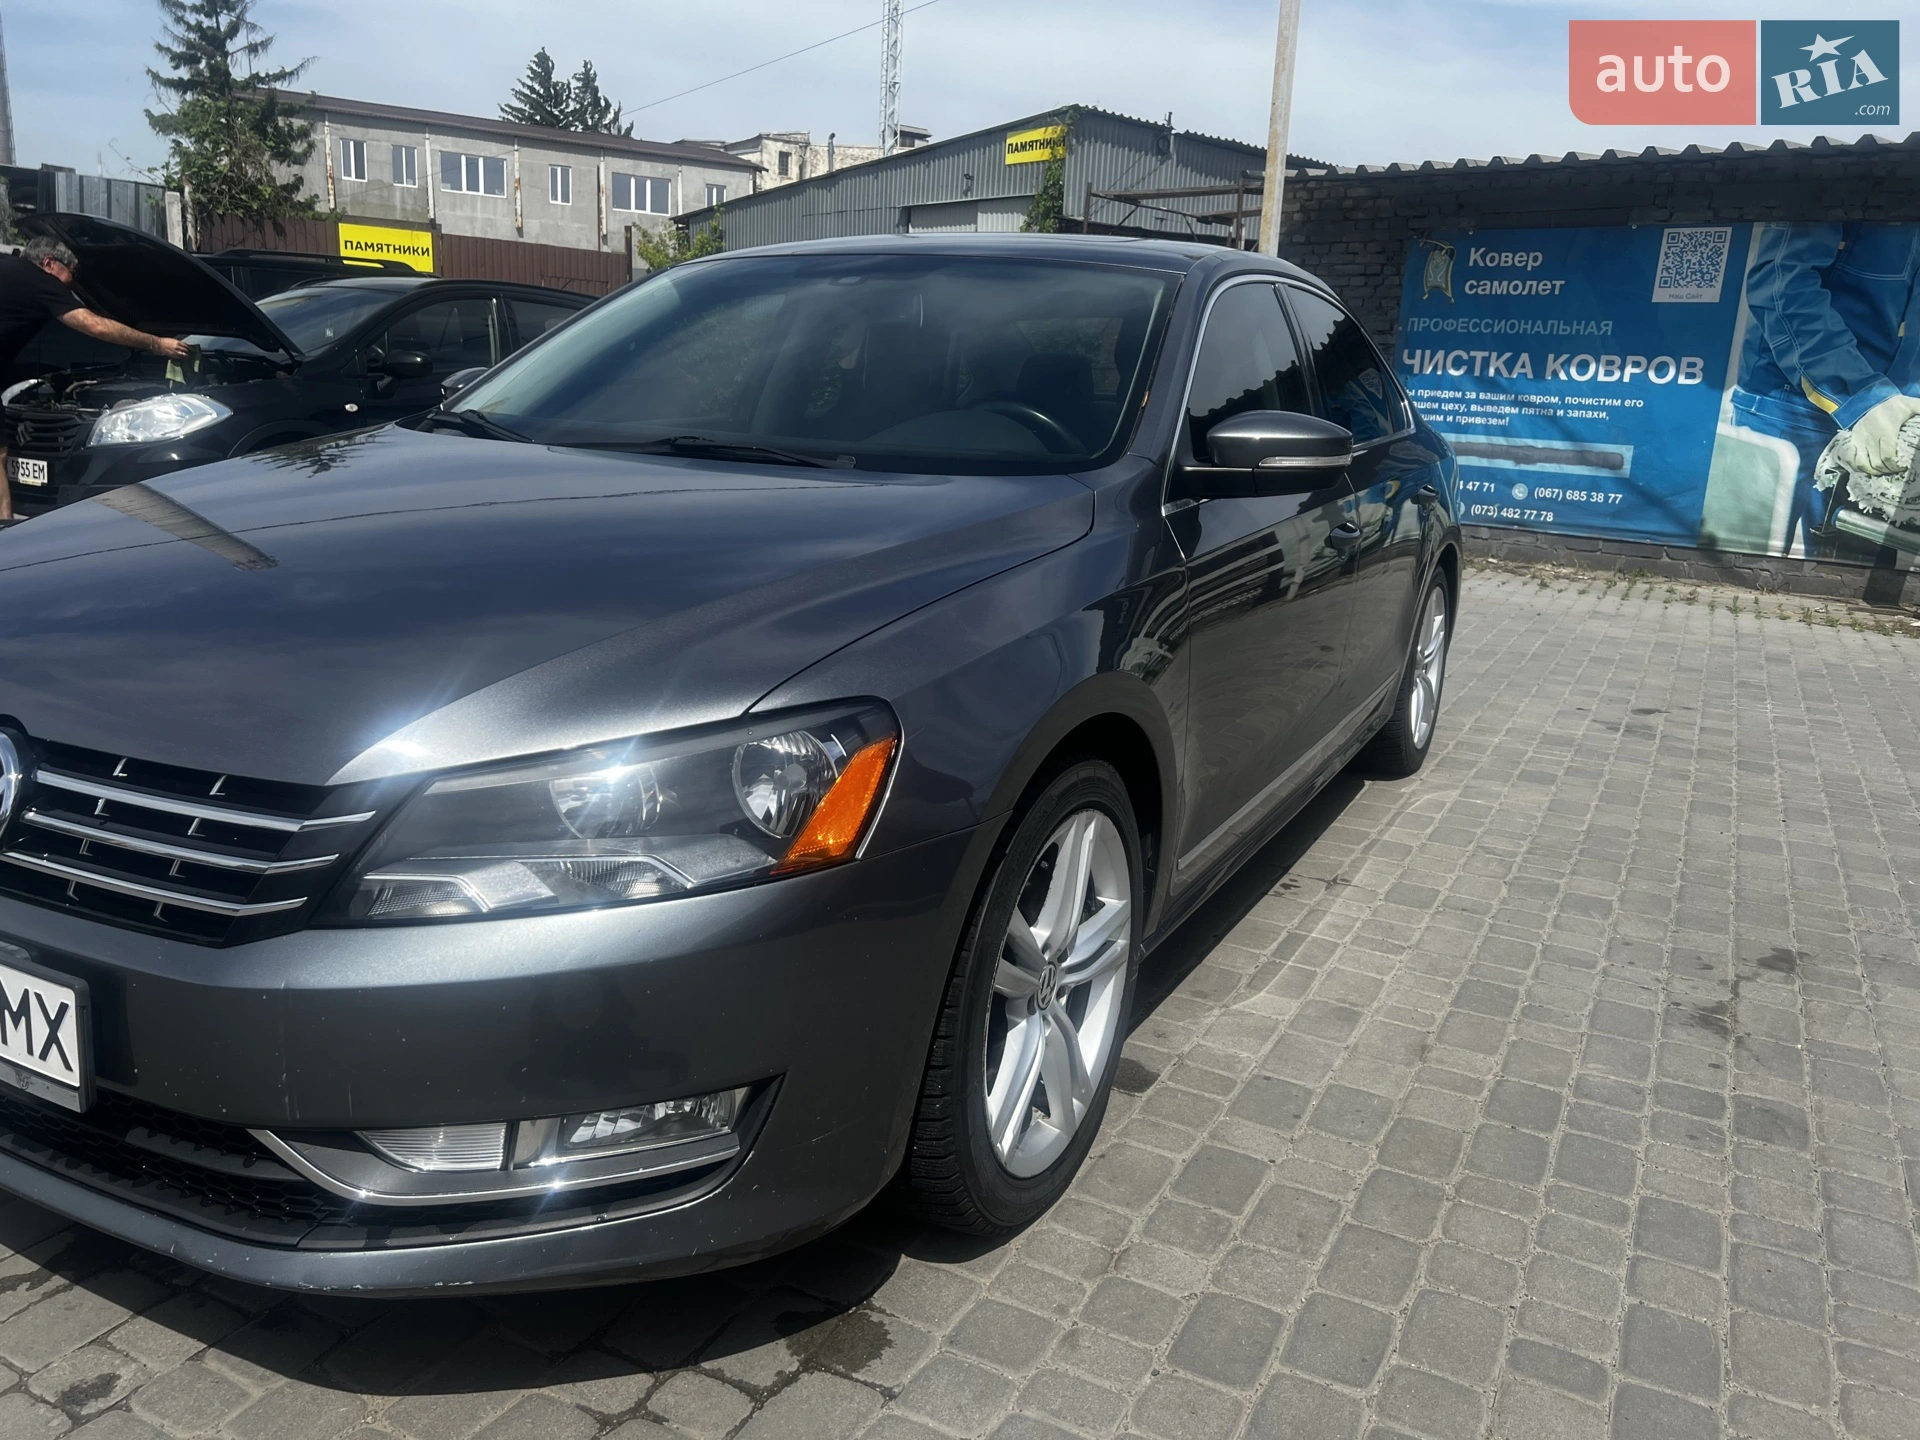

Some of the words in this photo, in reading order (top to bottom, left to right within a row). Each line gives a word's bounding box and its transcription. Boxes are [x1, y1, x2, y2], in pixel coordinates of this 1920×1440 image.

[344, 240, 430, 257] ПАМЯТНИКИ
[1468, 247, 1543, 270] Ковер
[1464, 279, 1565, 295] самолет
[1407, 317, 1613, 336] ПРОФЕССИОНАЛЬНАЯ
[1402, 349, 1534, 379] ЧИСТКА
[1545, 354, 1704, 385] КОВРОВ
[1417, 389, 1462, 399] приедем
[1464, 391, 1476, 399] за
[1479, 392, 1514, 401] вашим
[1517, 394, 1562, 405] ковром,
[1565, 396, 1621, 407] почистим
[1624, 399, 1644, 408] его
[1441, 402, 1468, 413] цеху,
[1470, 404, 1519, 415] выведем
[1521, 406, 1553, 416] пятна
[1556, 409, 1564, 417] и
[1566, 409, 1609, 420] запахи,
[1446, 415, 1454, 423] и
[1455, 416, 1509, 426] привезем!
[33, 463, 45, 480] EM
[1466, 481, 1480, 492] 47
[1483, 482, 1495, 493] 71
[1534, 487, 1563, 502] (067)
[1565, 489, 1587, 502] 685
[1589, 491, 1605, 503] 38
[1607, 493, 1623, 505] 77
[1471, 503, 1498, 519] (073)
[1501, 507, 1521, 519] 482
[1523, 509, 1538, 520] 77
[1540, 511, 1554, 522] 78
